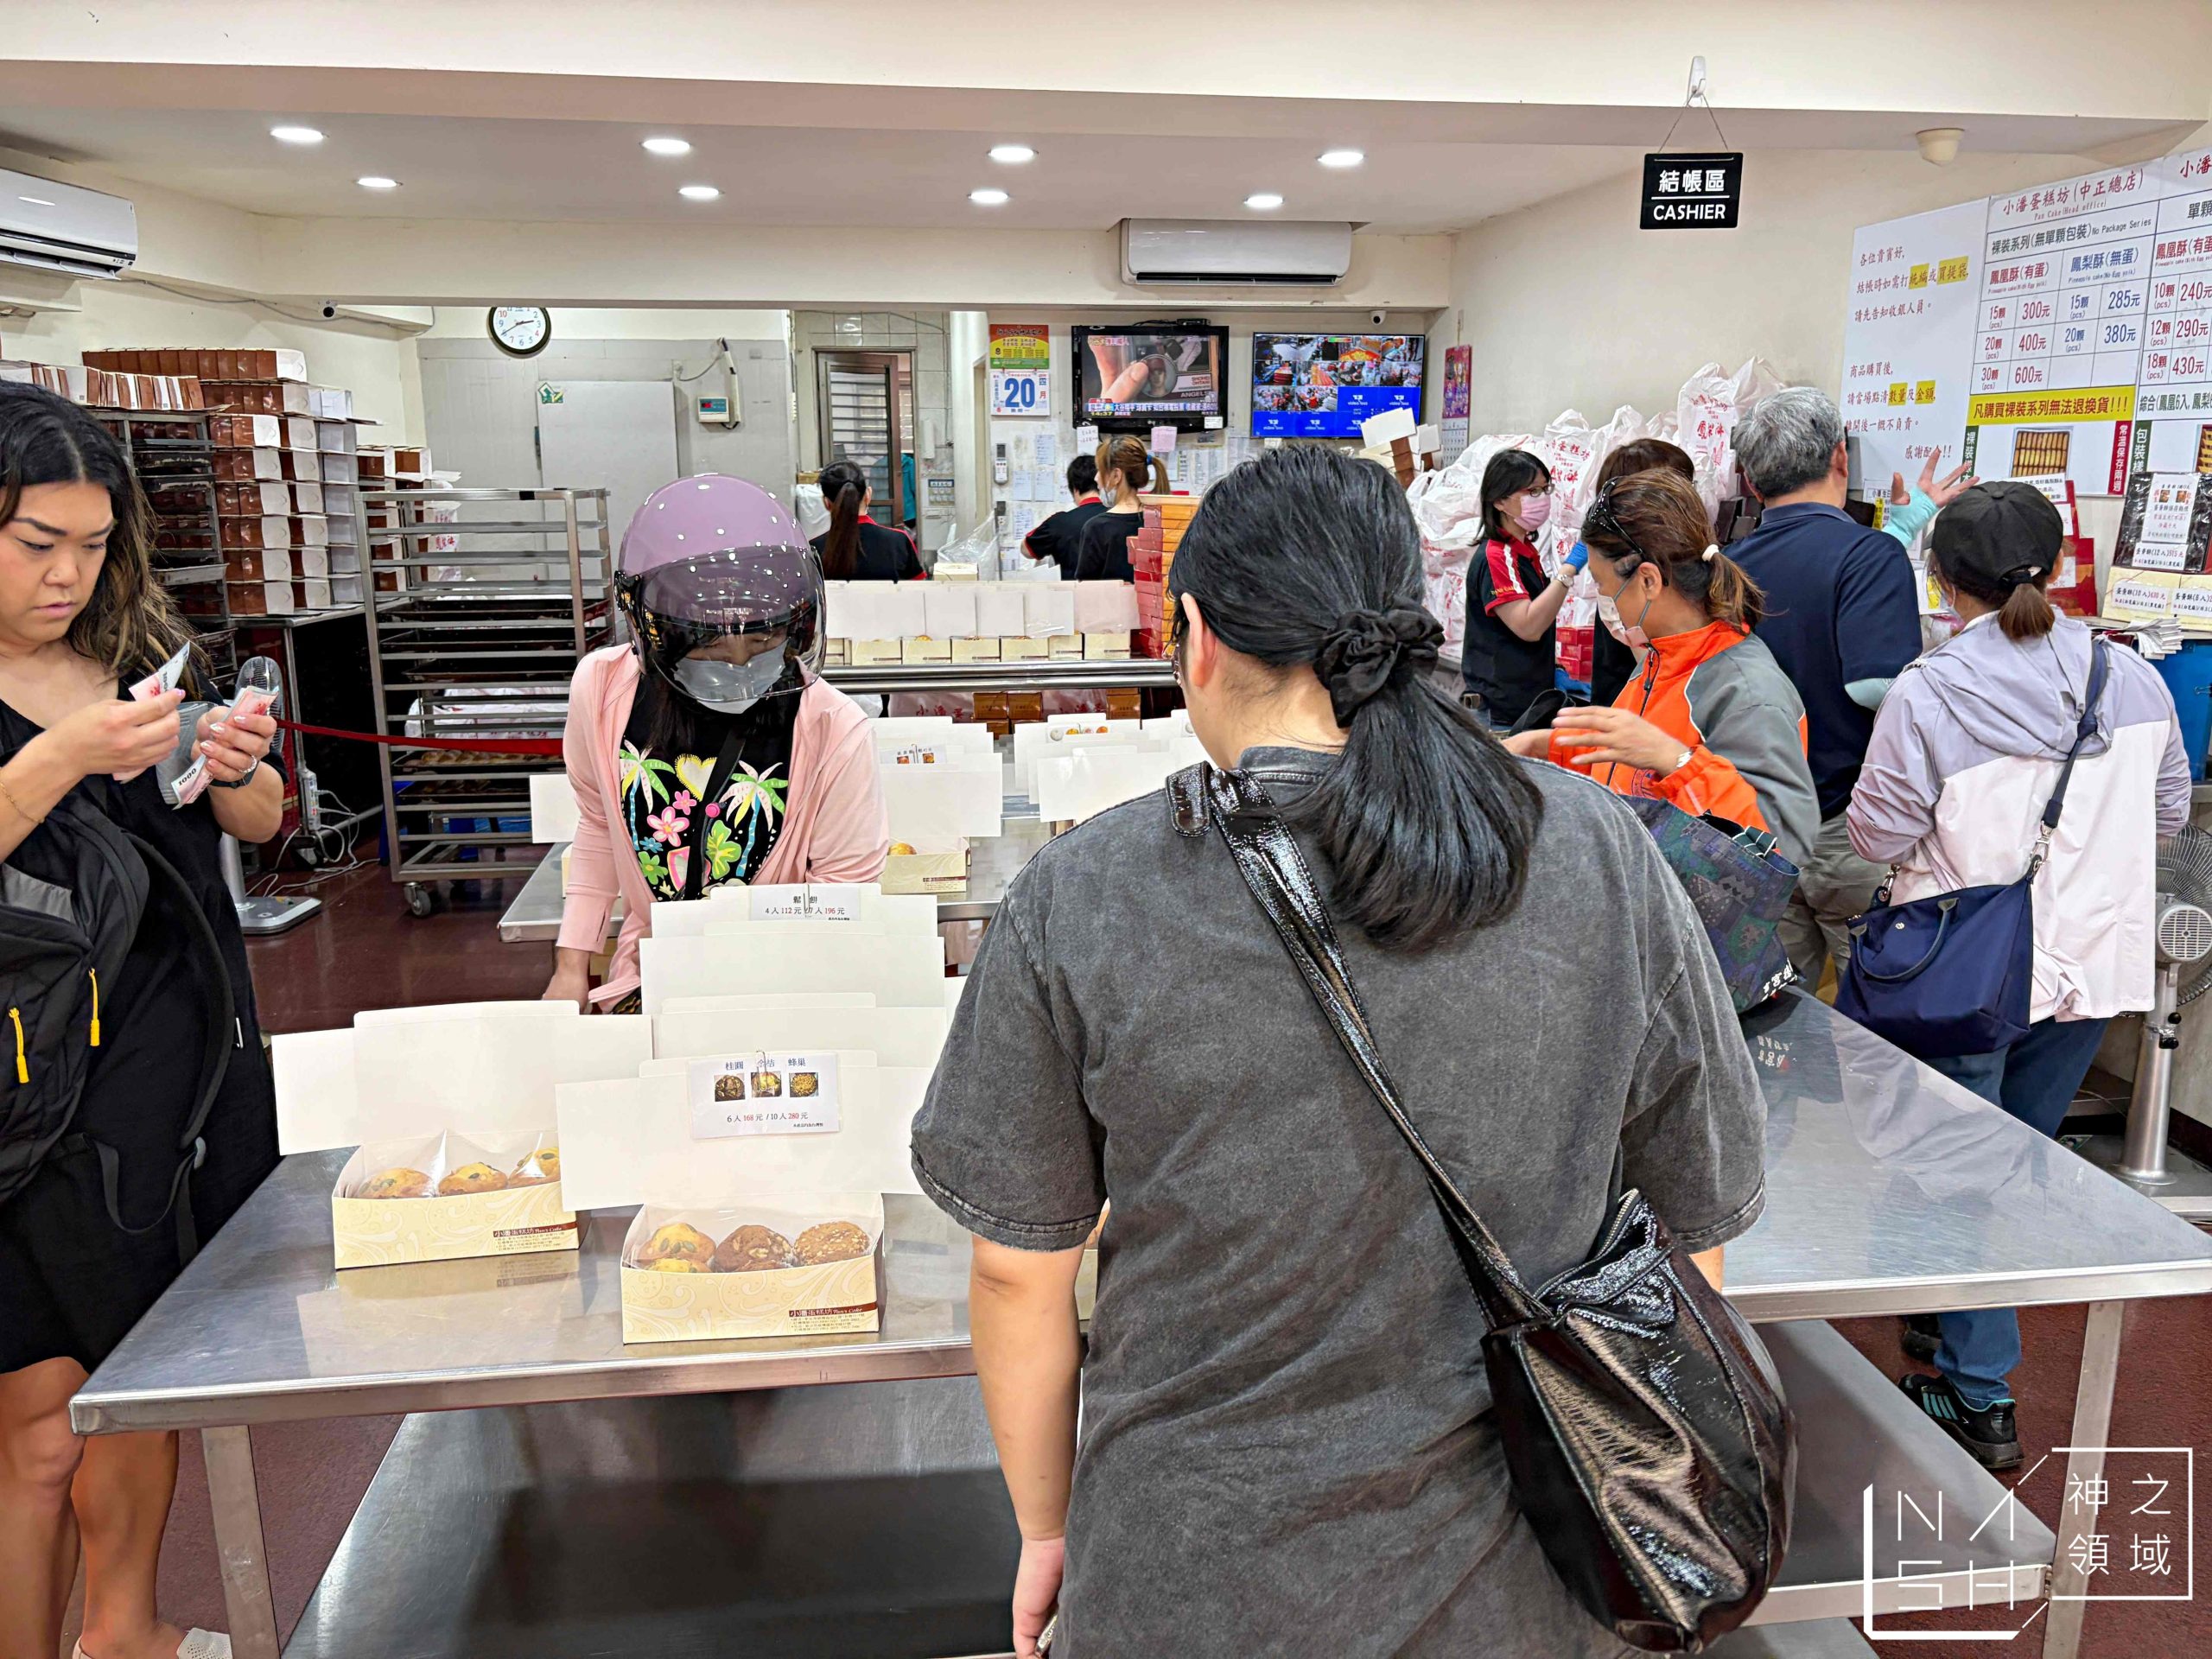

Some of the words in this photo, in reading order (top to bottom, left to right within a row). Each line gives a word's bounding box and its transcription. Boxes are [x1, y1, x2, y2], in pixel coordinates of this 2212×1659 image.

[1658, 169, 1726, 193] 結帳區
[1653, 204, 1726, 220] CASHIER
[2130, 217, 2152, 228] Series
[2107, 289, 2141, 310] 285元
[2154, 300, 2171, 309] (pcs)
[2022, 301, 2050, 321] 300元
[2069, 310, 2085, 320] (pcs)
[1989, 321, 2003, 329] (pcs)
[2176, 318, 2209, 339] 290元
[2104, 324, 2137, 344] 380元
[2150, 337, 2168, 346] (pcs)
[2018, 333, 2047, 353] 400元
[2065, 344, 2082, 353] (pcs)
[1986, 352, 1999, 360] (pcs)
[2171, 355, 2204, 376] 430元
[2014, 365, 2043, 385] 600元
[2146, 371, 2164, 380] (pcs)
[1004, 378, 1035, 408] 20
[1982, 382, 1996, 391] (pcs)
[178, 767, 197, 786] 1000
